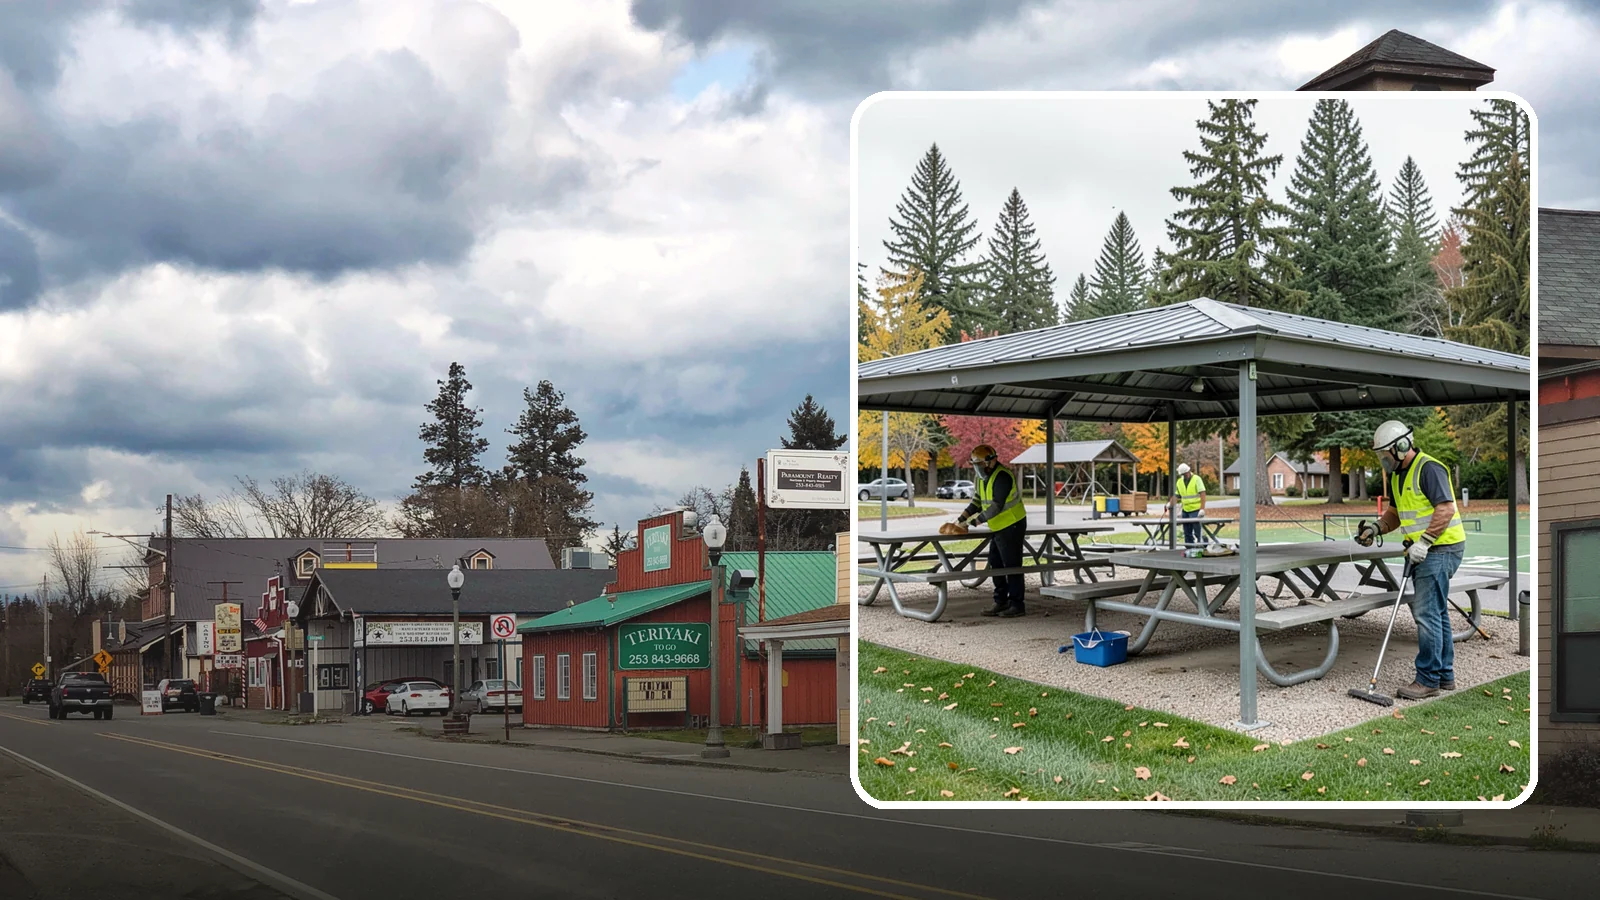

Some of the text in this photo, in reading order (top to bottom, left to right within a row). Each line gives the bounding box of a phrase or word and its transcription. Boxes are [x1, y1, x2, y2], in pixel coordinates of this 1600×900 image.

[646, 531, 668, 549] TERIYAKI
[625, 627, 702, 646] TERIYAKI
[629, 654, 700, 665] 253 843-9668
[639, 681, 672, 691] TERIYAKI
